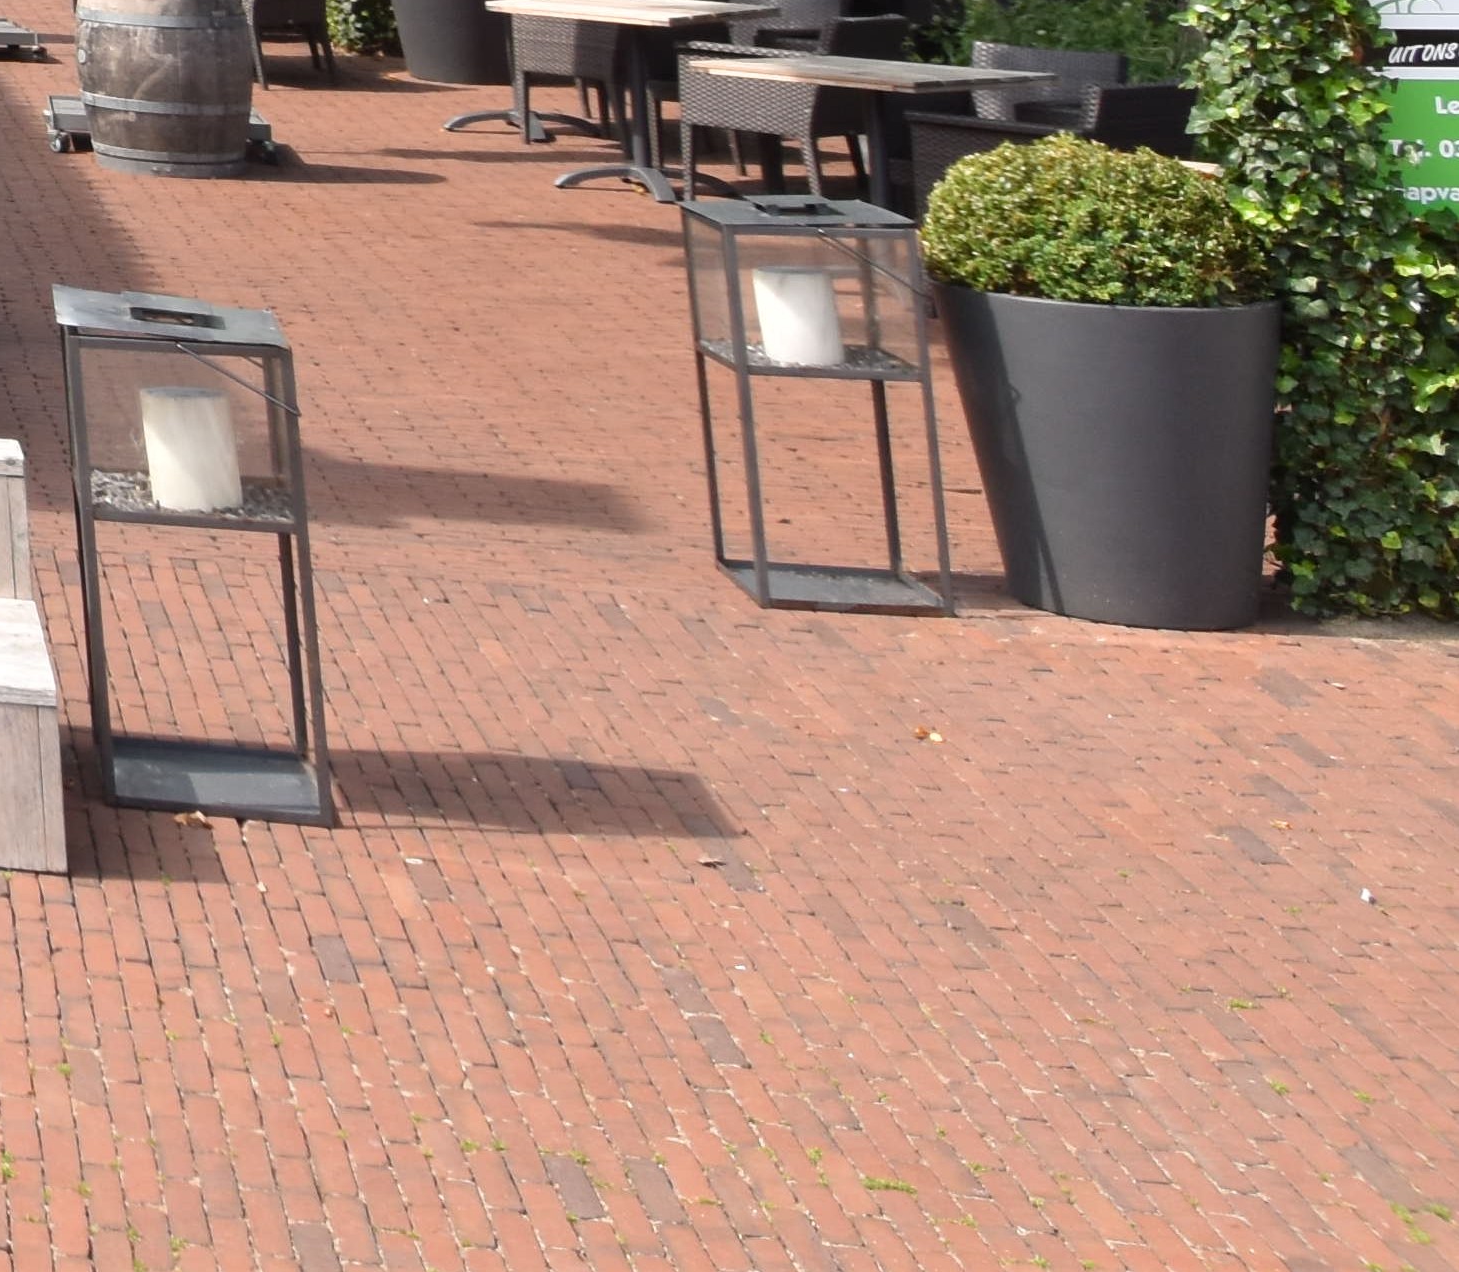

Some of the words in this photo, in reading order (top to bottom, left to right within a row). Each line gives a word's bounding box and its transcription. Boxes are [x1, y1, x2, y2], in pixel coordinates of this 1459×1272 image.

[1388, 44, 1424, 64] UIT
[1421, 42, 1459, 63] ONS
[1402, 186, 1459, 205] apva
